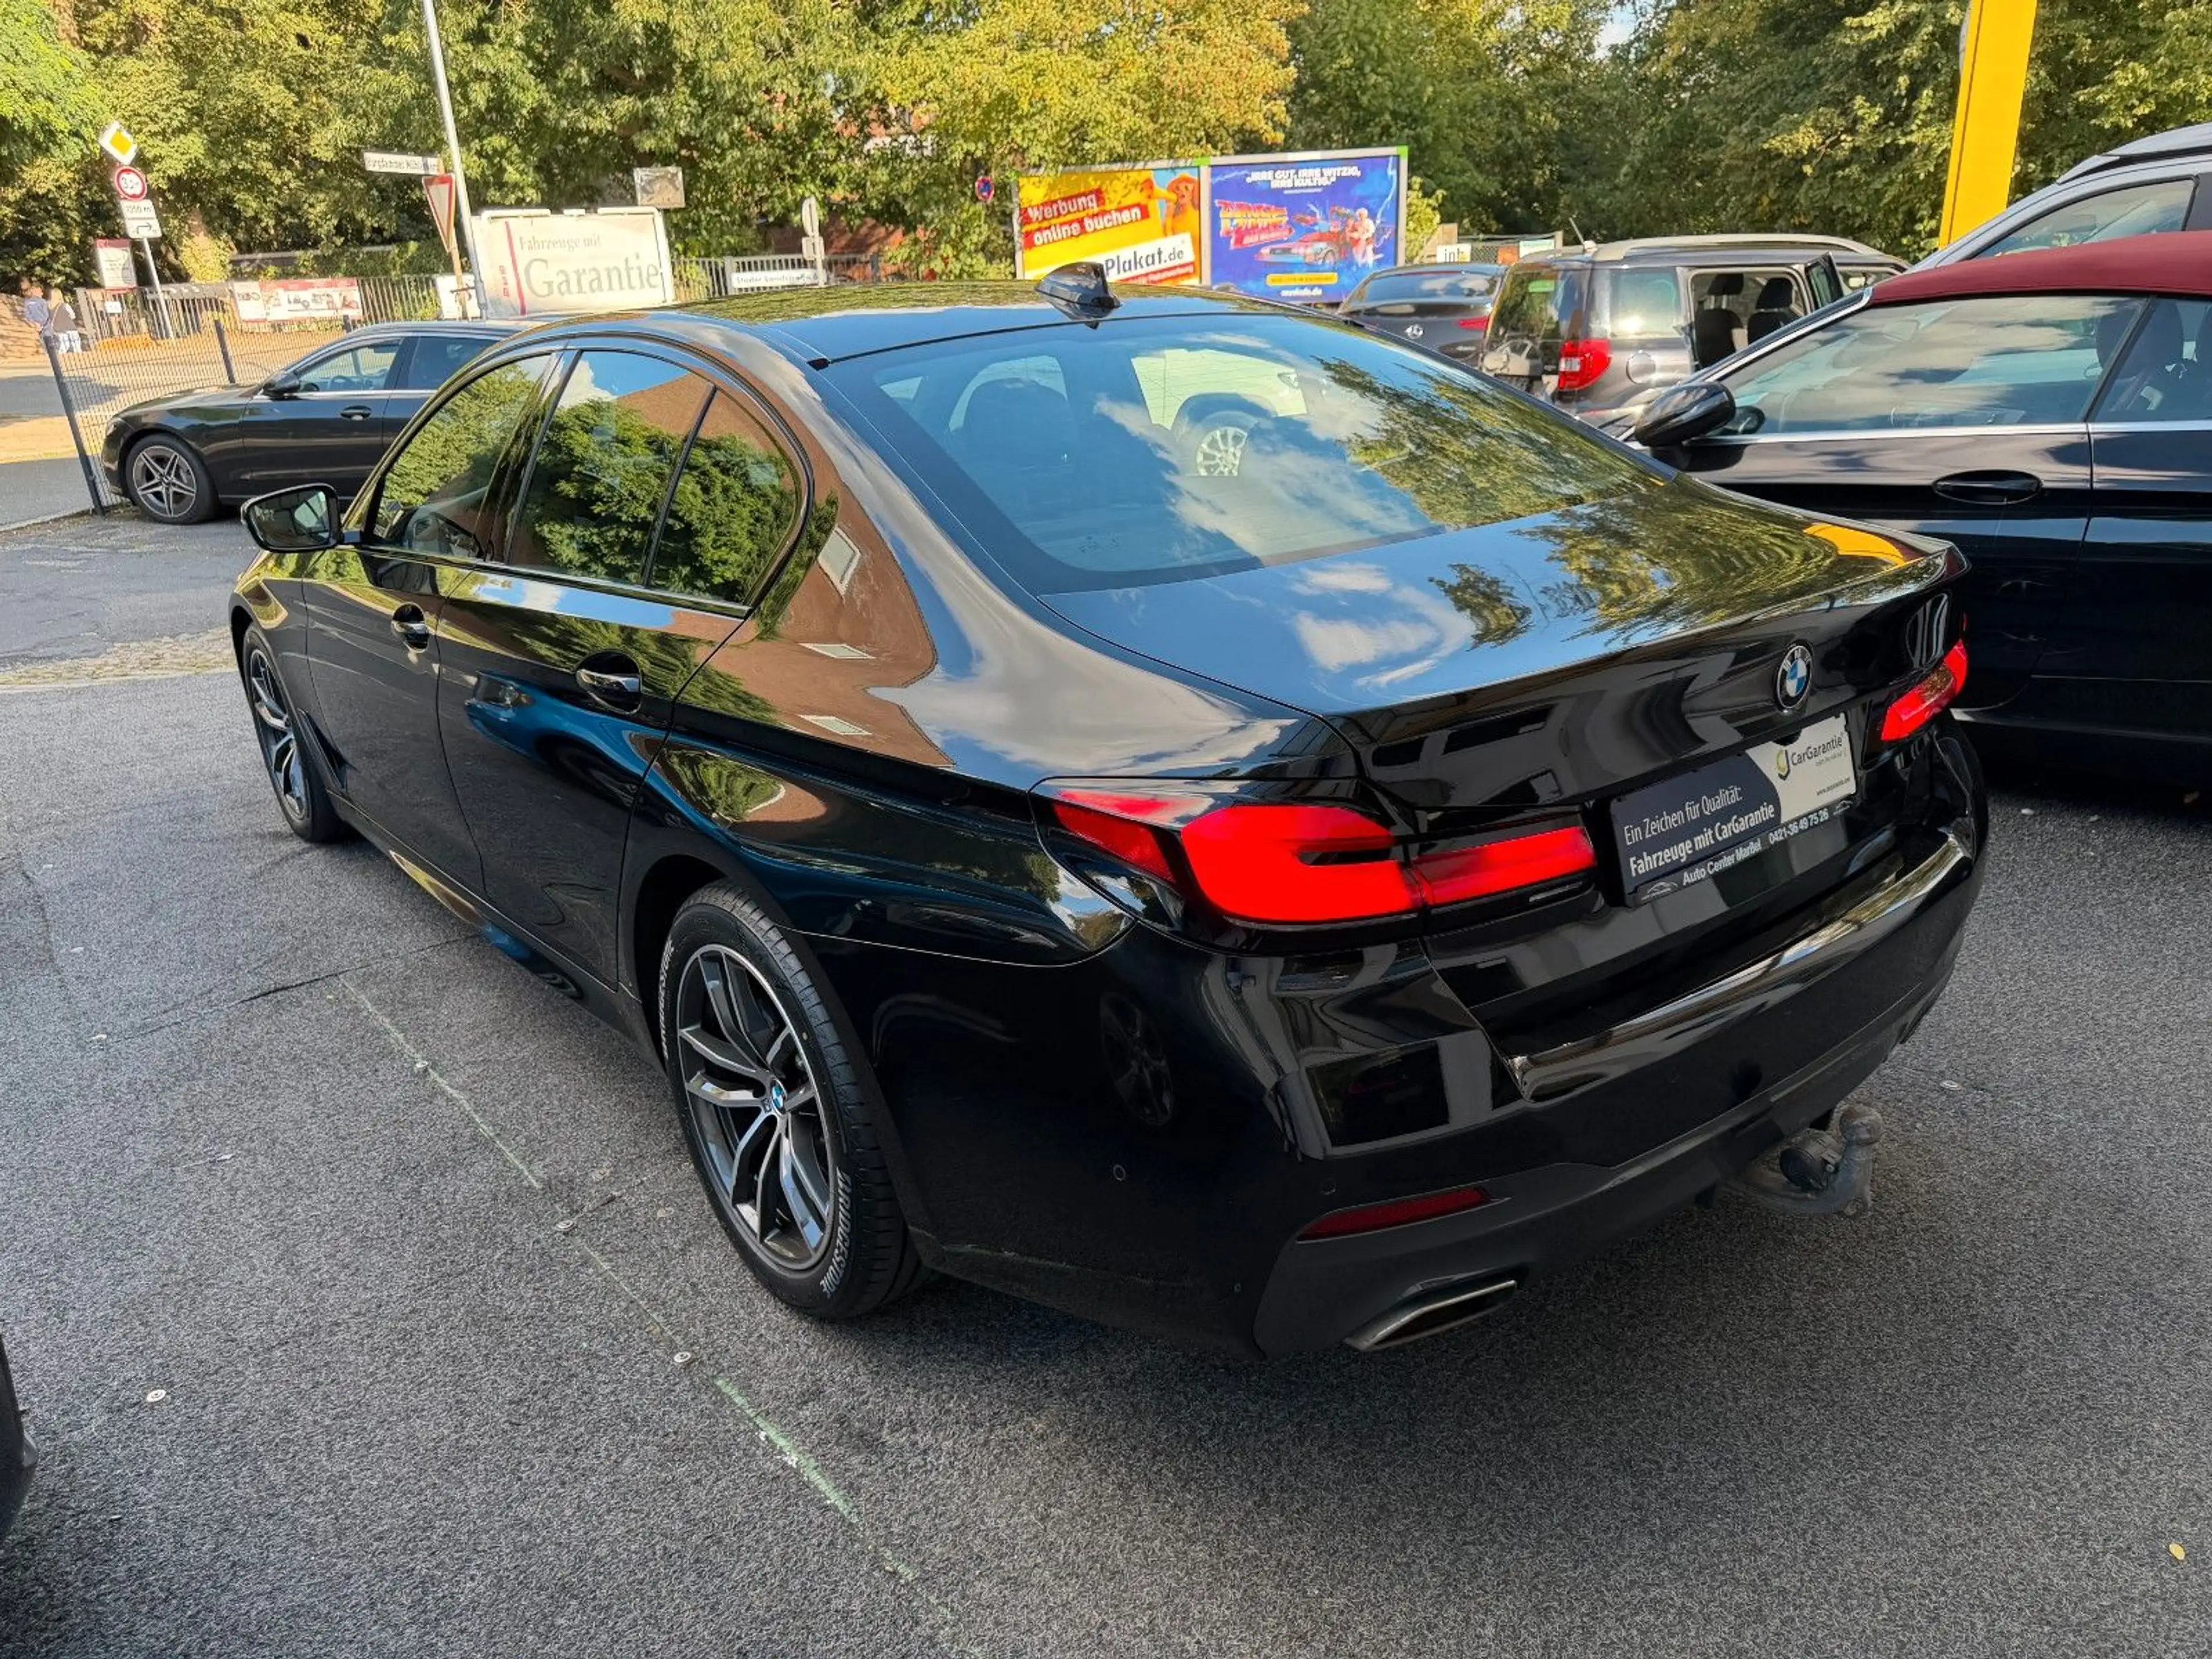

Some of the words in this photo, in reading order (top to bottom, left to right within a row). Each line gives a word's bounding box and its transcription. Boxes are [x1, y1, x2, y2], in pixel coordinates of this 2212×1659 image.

[1028, 193, 1098, 221] Werbung
[519, 235, 580, 252] Fahrzeuge
[583, 233, 601, 248] mit
[1033, 222, 1081, 245] online
[1084, 207, 1141, 232] buchen
[524, 252, 661, 298] Garantie
[1782, 647, 1811, 672] BMW
[1791, 735, 1843, 766] CarGarantie
[1624, 824, 1643, 845] Ein
[1643, 810, 1685, 838] Zeichen
[1685, 801, 1700, 821] für
[1630, 843, 1693, 877] Fahrzeuge
[1694, 826, 1715, 850] mit
[1714, 802, 1775, 842] CarGarantie
[1683, 866, 1706, 885] Auto
[1707, 853, 1735, 874] Center
[820, 1166, 851, 1298] BRIDGESTONE
